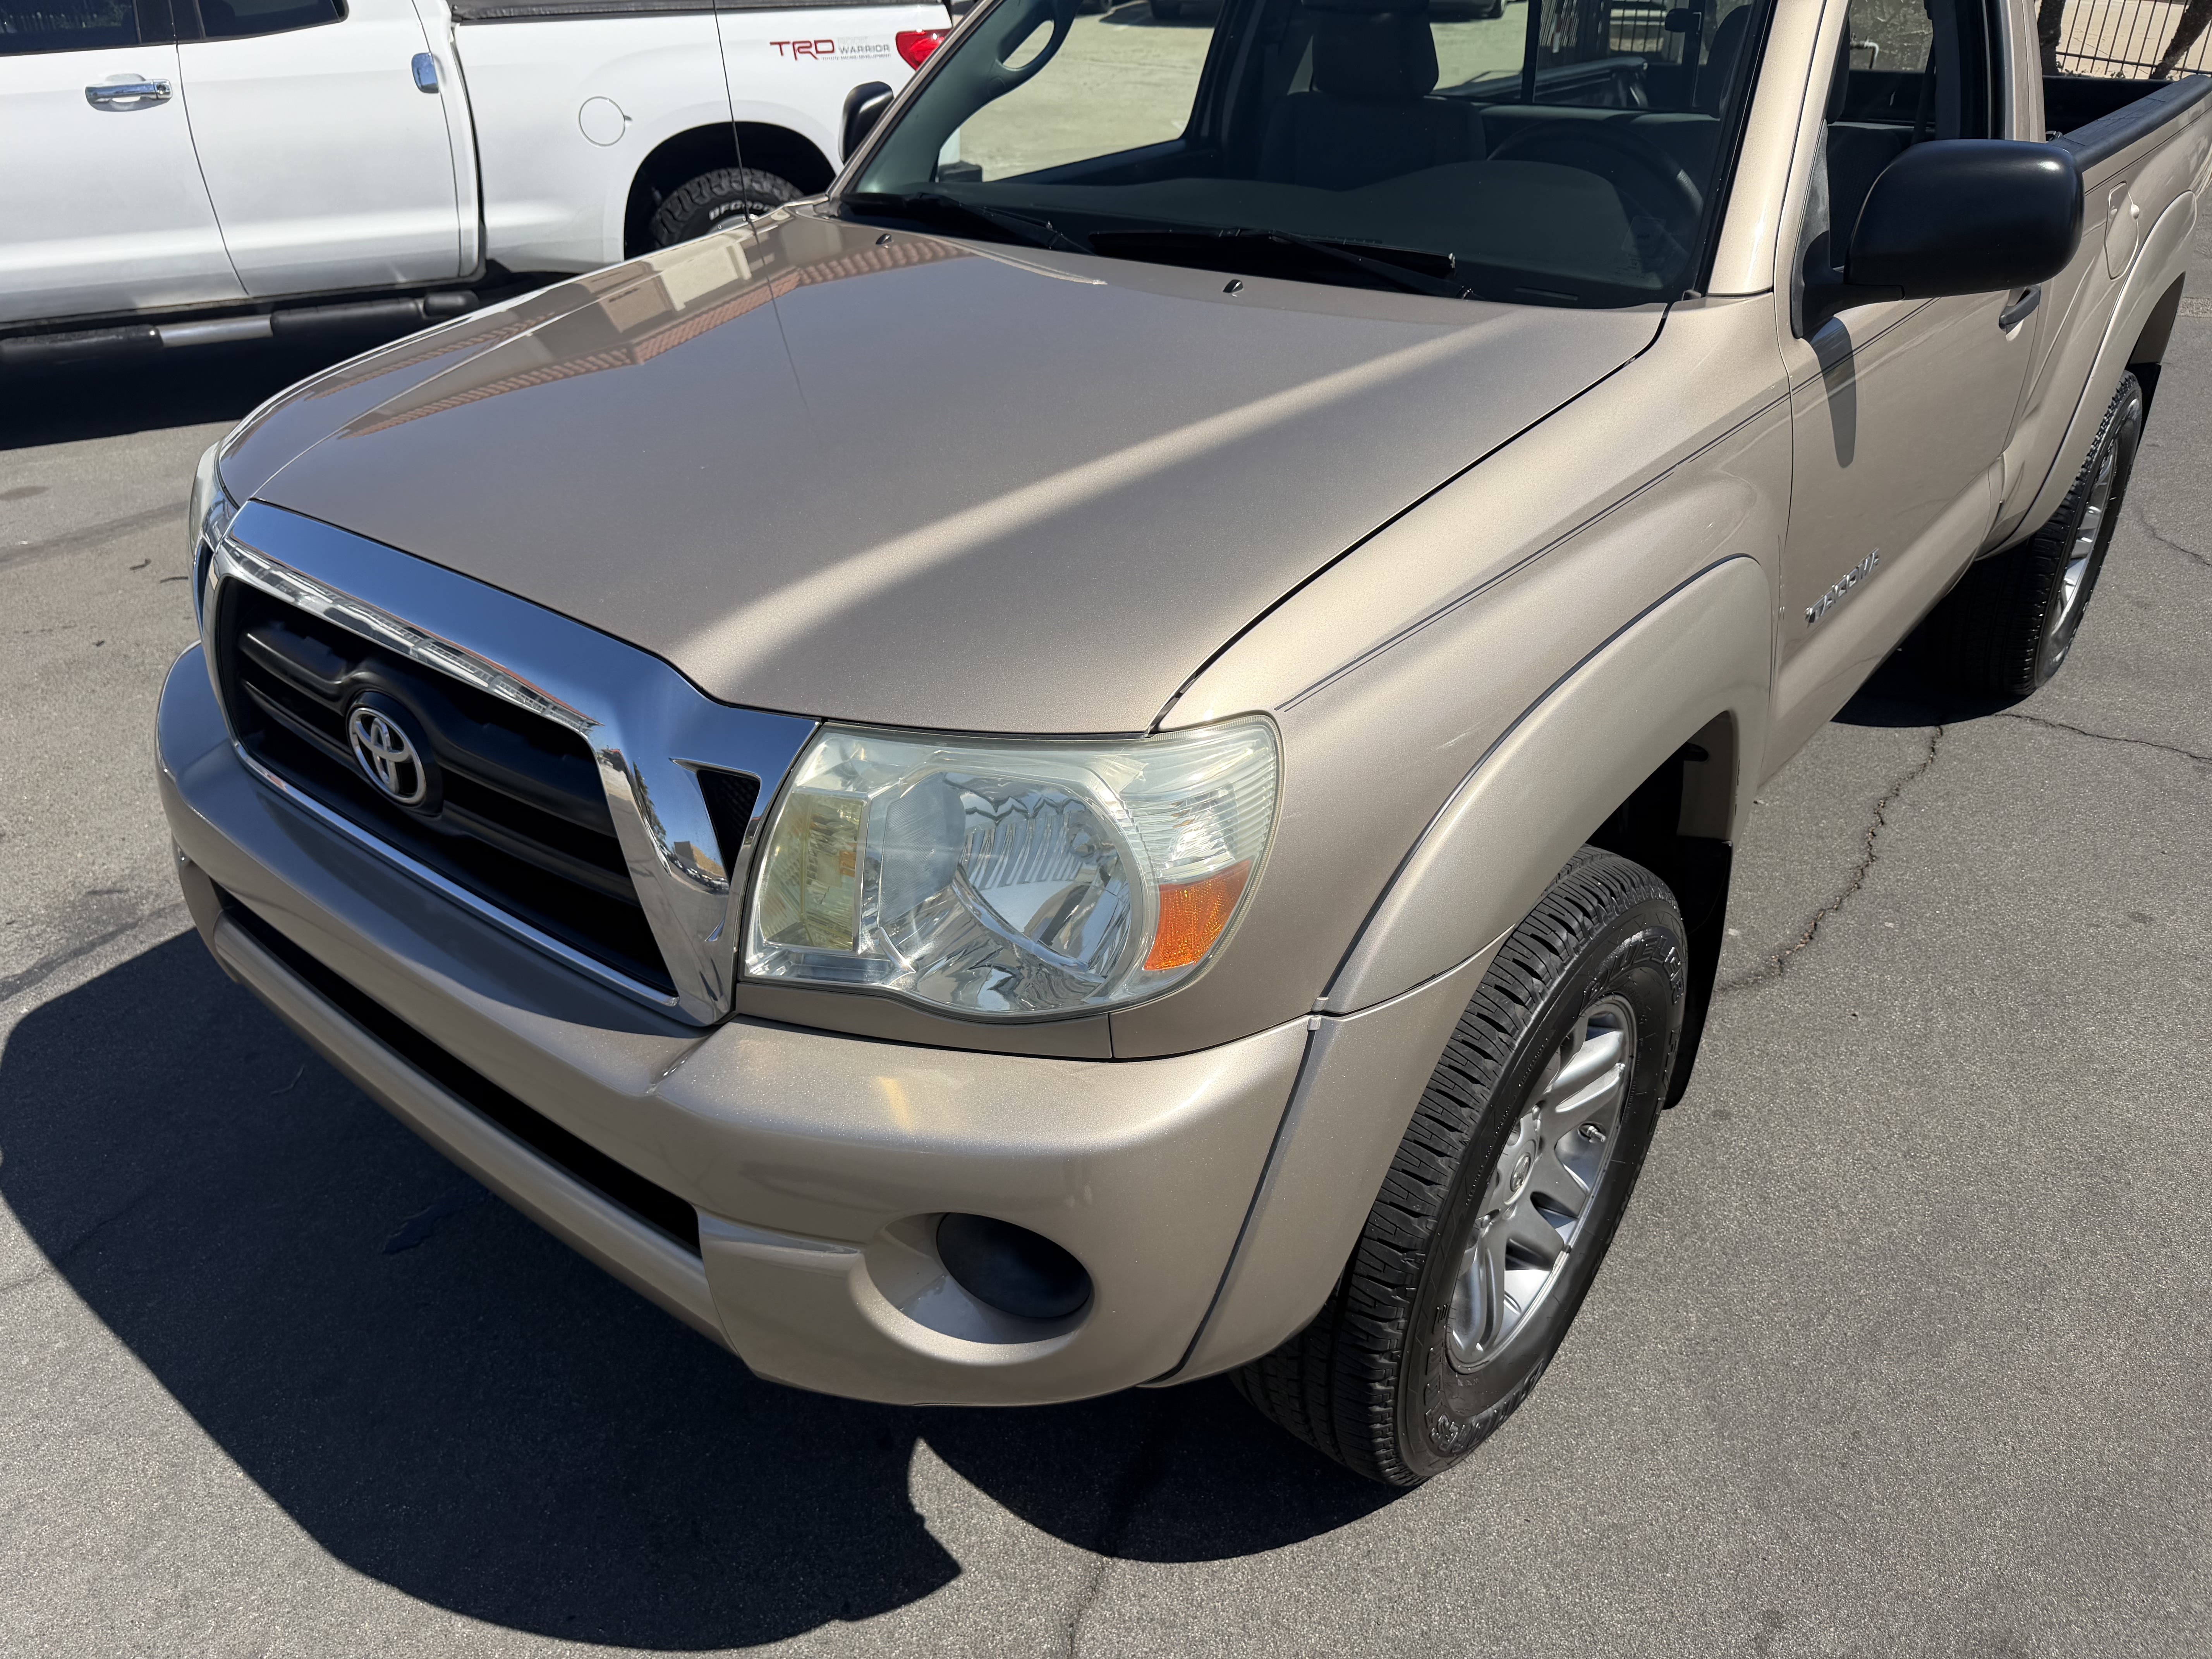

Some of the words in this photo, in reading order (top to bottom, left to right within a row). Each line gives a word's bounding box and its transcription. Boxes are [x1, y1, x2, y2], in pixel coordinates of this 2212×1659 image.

[769, 39, 835, 61] TRD
[838, 44, 890, 54] WARRIOR
[1803, 548, 1880, 629] TACOMA
